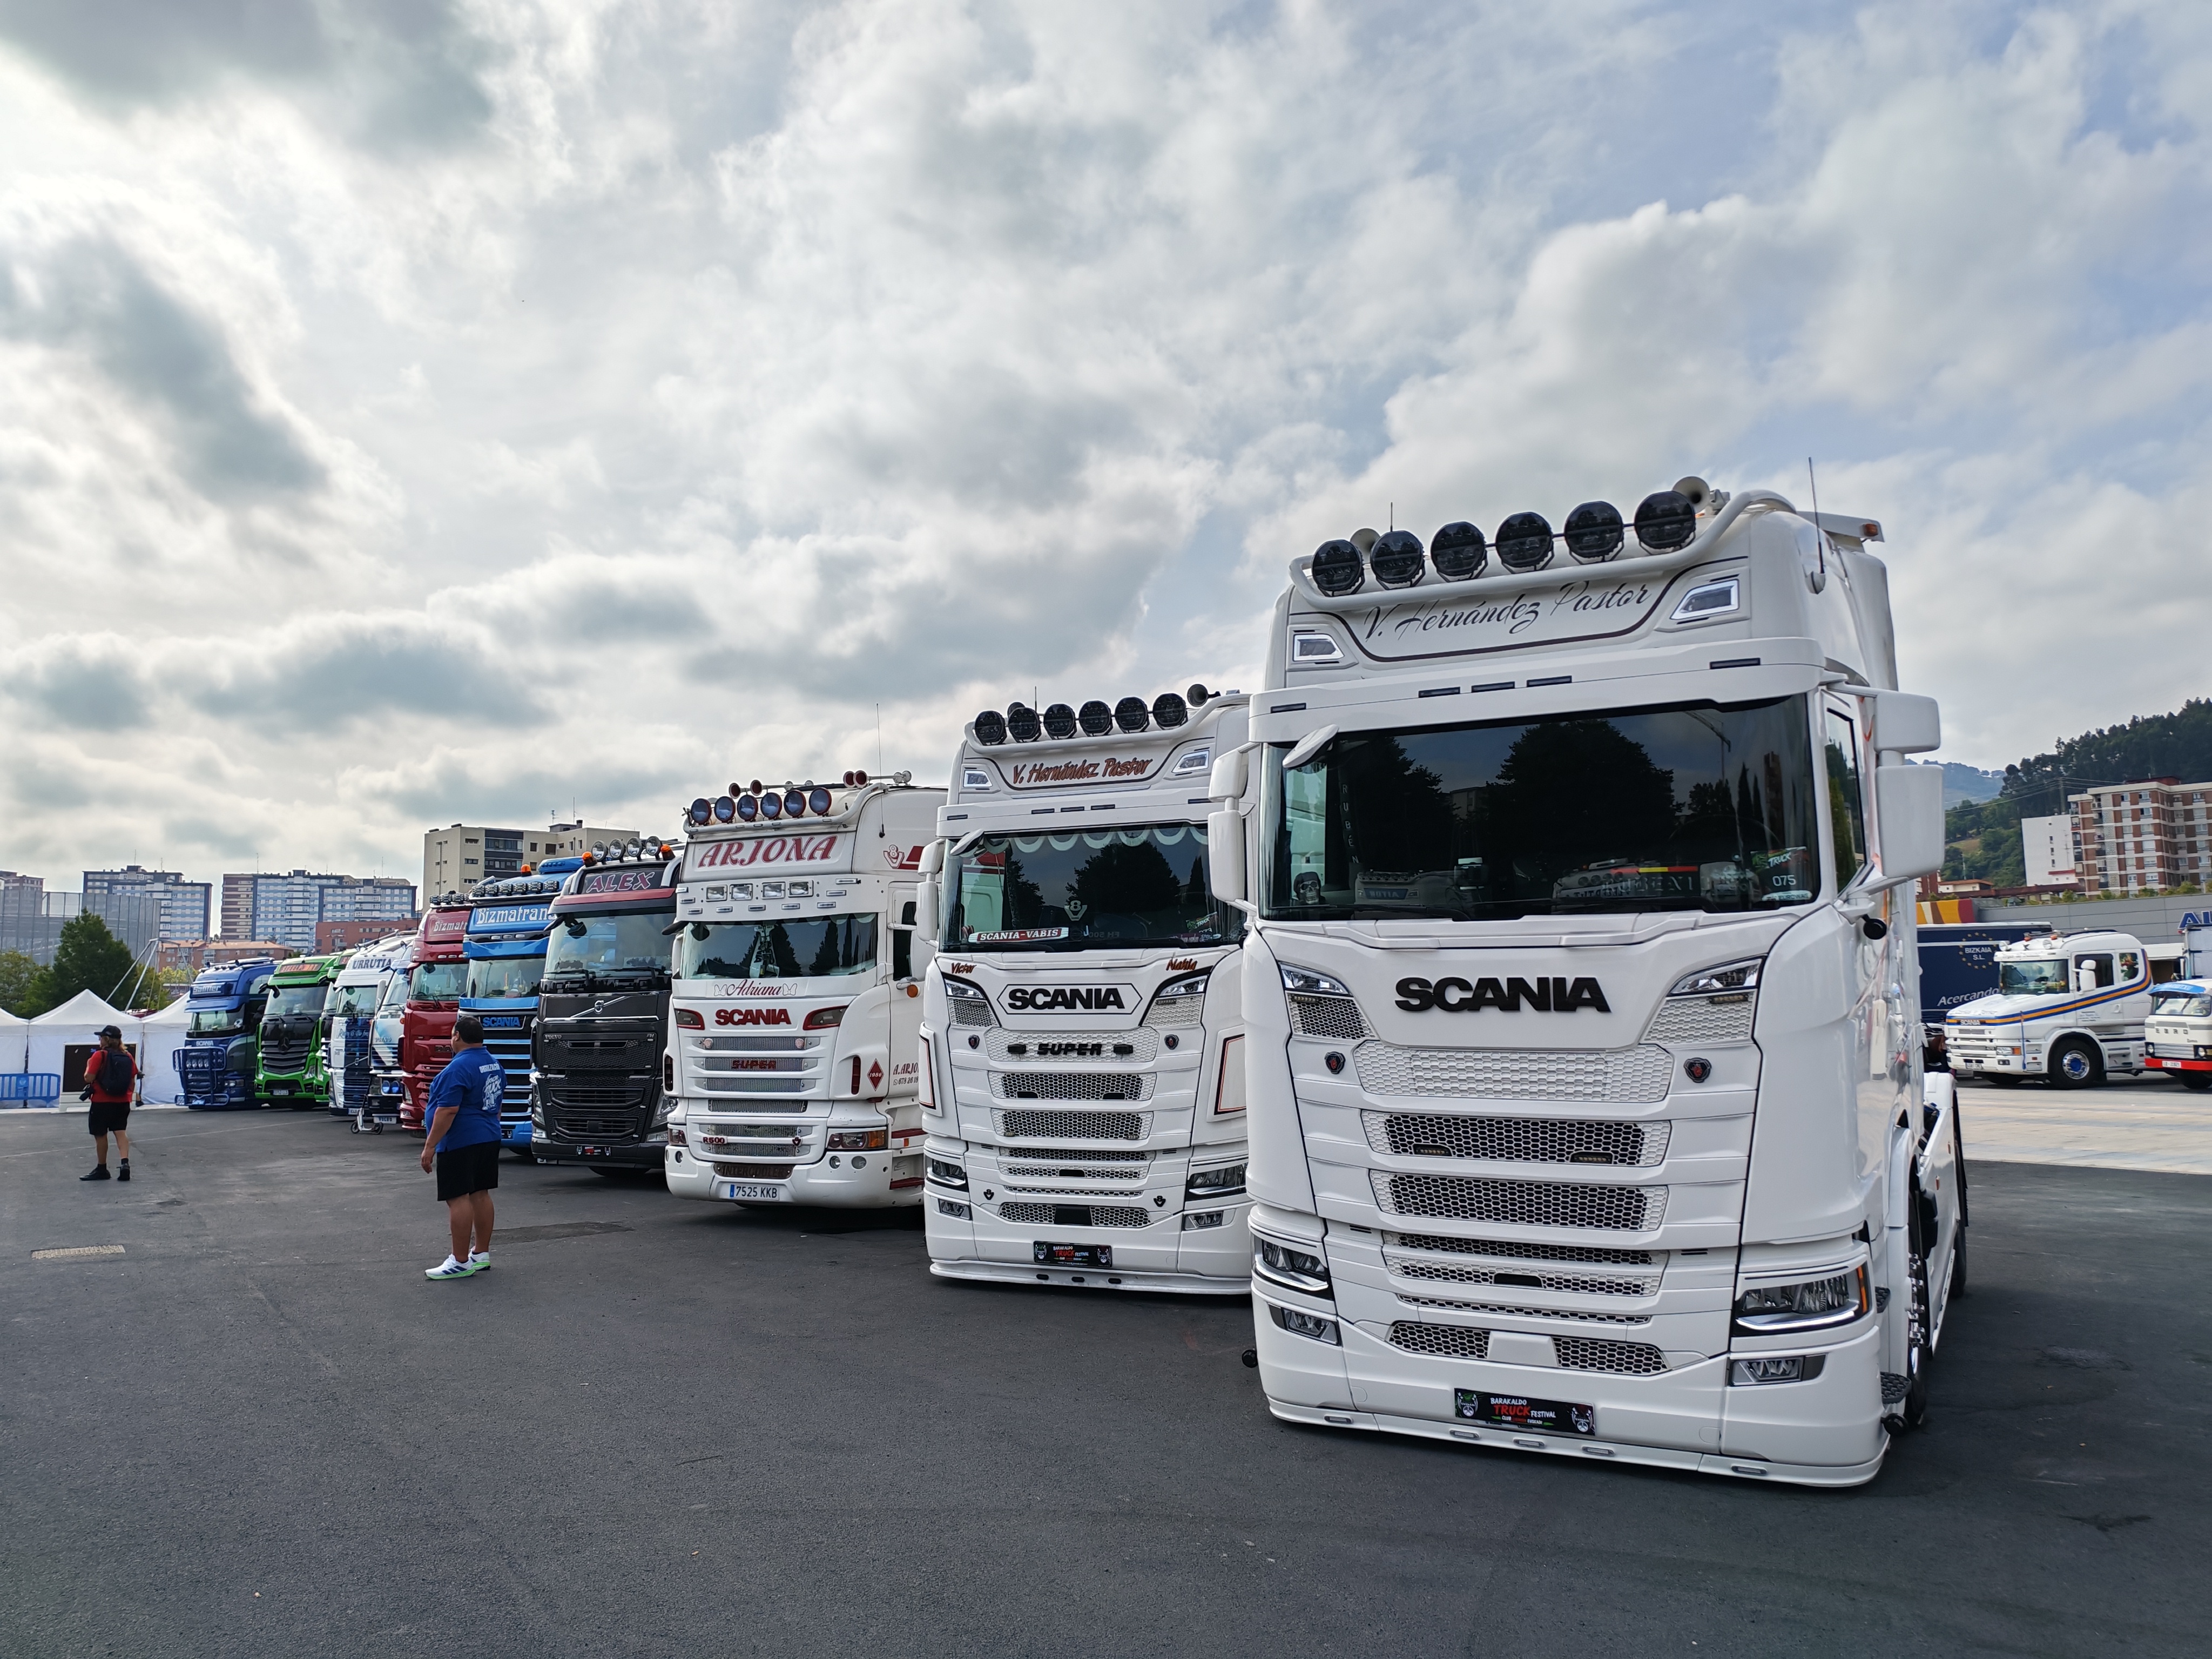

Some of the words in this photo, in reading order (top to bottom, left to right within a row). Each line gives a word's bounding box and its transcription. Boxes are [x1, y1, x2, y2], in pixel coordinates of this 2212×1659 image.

[1363, 603, 1403, 643] V.
[1395, 592, 1541, 641] Hernández
[1550, 580, 1652, 616] Pastor
[1013, 763, 1027, 784] V.
[1027, 759, 1100, 783] Hernández
[1101, 757, 1153, 777] Pastor
[1342, 784, 1359, 864] RUBÉN
[697, 835, 838, 868] ARJONA
[1768, 852, 1792, 867] TRUCK
[586, 872, 655, 893] ALEX
[1772, 874, 1797, 887] 075
[433, 920, 468, 932] Bizmatr
[980, 929, 1058, 941] SCANIA-VABIS
[353, 959, 391, 969] URRUTIA
[726, 979, 783, 996] Adriana
[1394, 976, 1611, 1013] SCANIA
[1008, 988, 1125, 1010] SCANIA
[1937, 987, 1999, 1007] Acercando
[482, 1017, 521, 1027] SCANIA
[714, 1009, 792, 1026] SCANIA
[1037, 1043, 1103, 1056] SUPER
[731, 1060, 777, 1069] SUPER
[893, 1062, 919, 1075] A.ARJO
[736, 1186, 757, 1197] 7525
[760, 1188, 777, 1198] KKB
[1493, 1405, 1531, 1416] TRUCK
[1530, 1410, 1556, 1418] FESTIVAL
